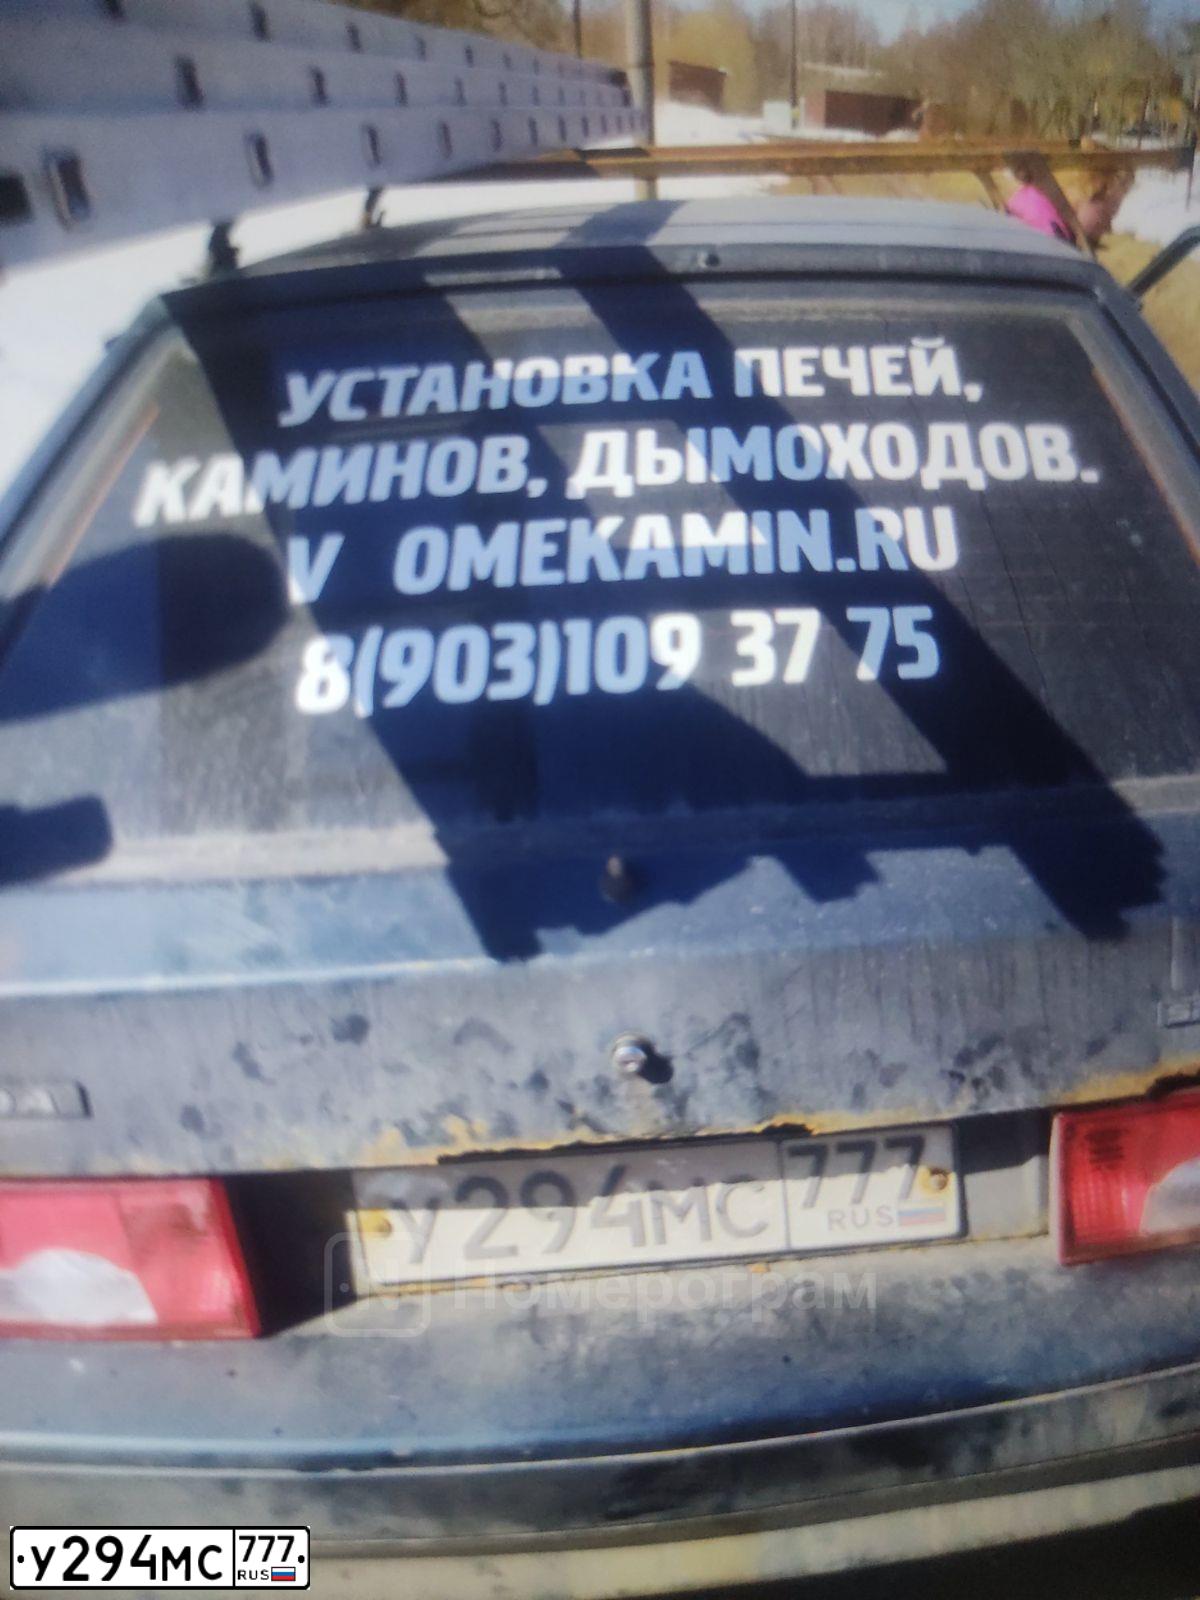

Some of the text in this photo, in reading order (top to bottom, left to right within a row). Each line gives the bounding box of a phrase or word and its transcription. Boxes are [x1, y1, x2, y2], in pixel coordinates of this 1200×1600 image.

[278, 337, 984, 427] УСТАНОВКА ПЕЧЕЙ,
[134, 421, 1099, 527] КАМИНОВ, ДЫМОХОДОВ.
[295, 605, 940, 718] 8(903)109 37 75
[786, 1134, 926, 1208] 777
[826, 1204, 895, 1232] RUS
